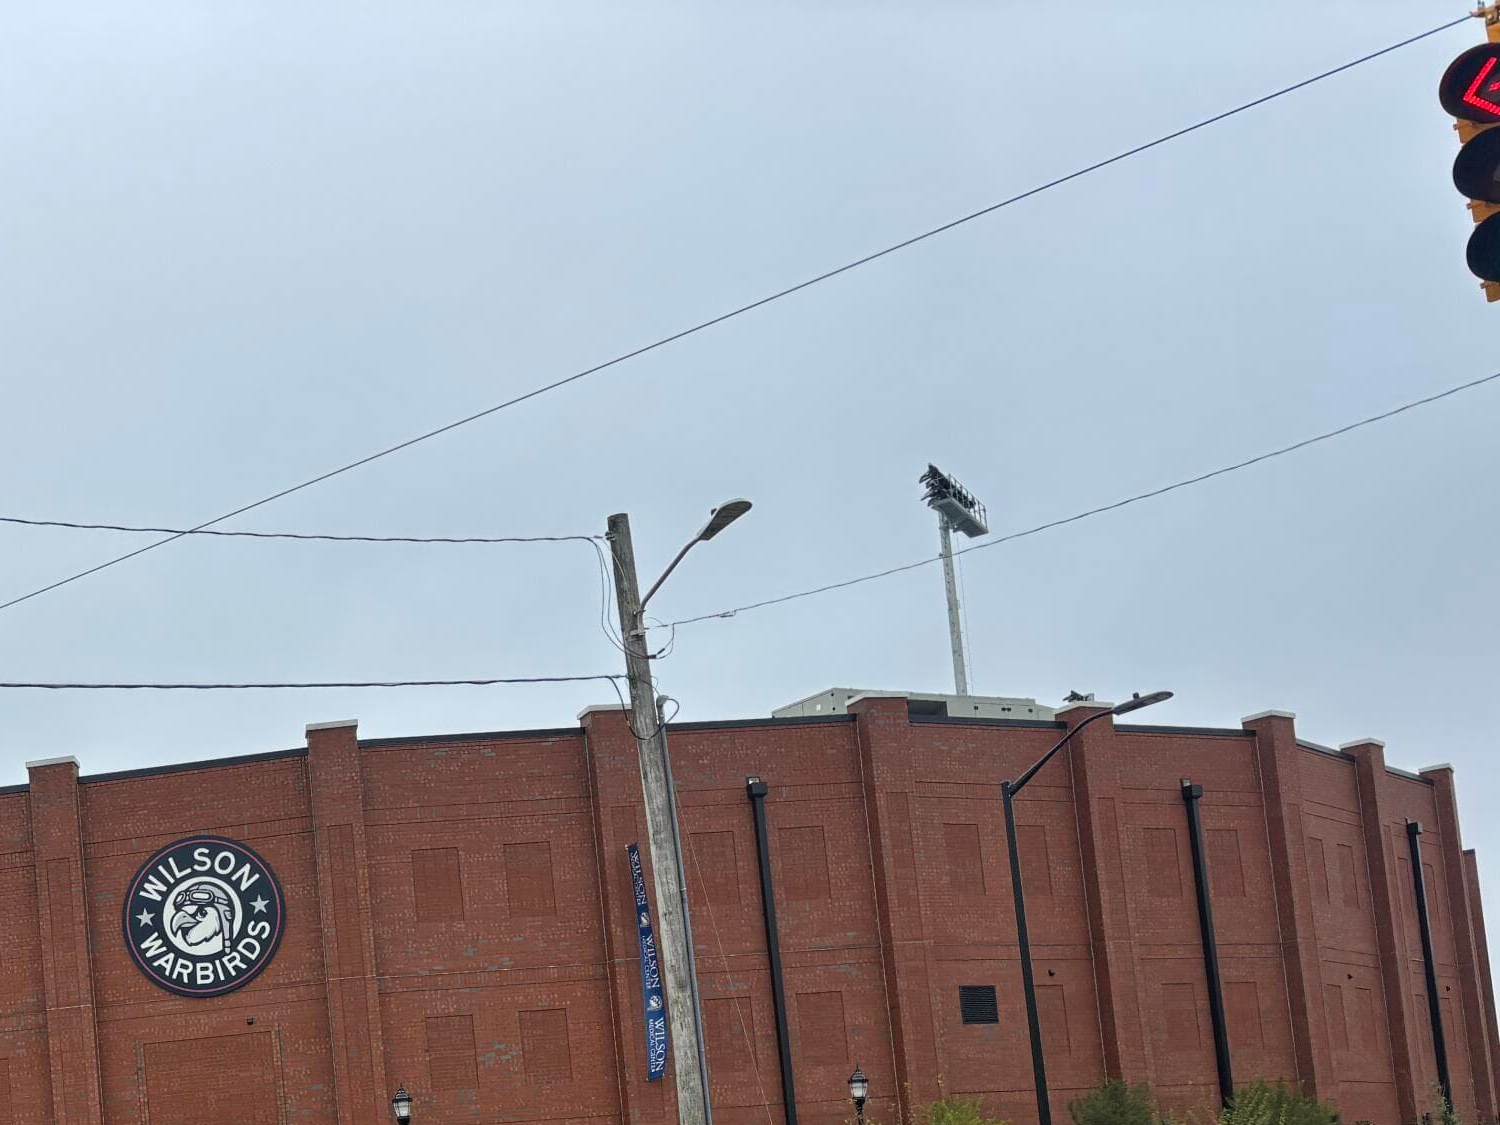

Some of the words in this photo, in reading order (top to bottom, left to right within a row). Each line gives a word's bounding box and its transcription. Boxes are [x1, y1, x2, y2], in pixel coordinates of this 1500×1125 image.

[139, 848, 260, 901] WILSON
[633, 850, 647, 905] WILSON
[140, 921, 271, 985] WARBIRDS
[646, 933, 660, 988] WILSON
[655, 1017, 666, 1072] WILSON
